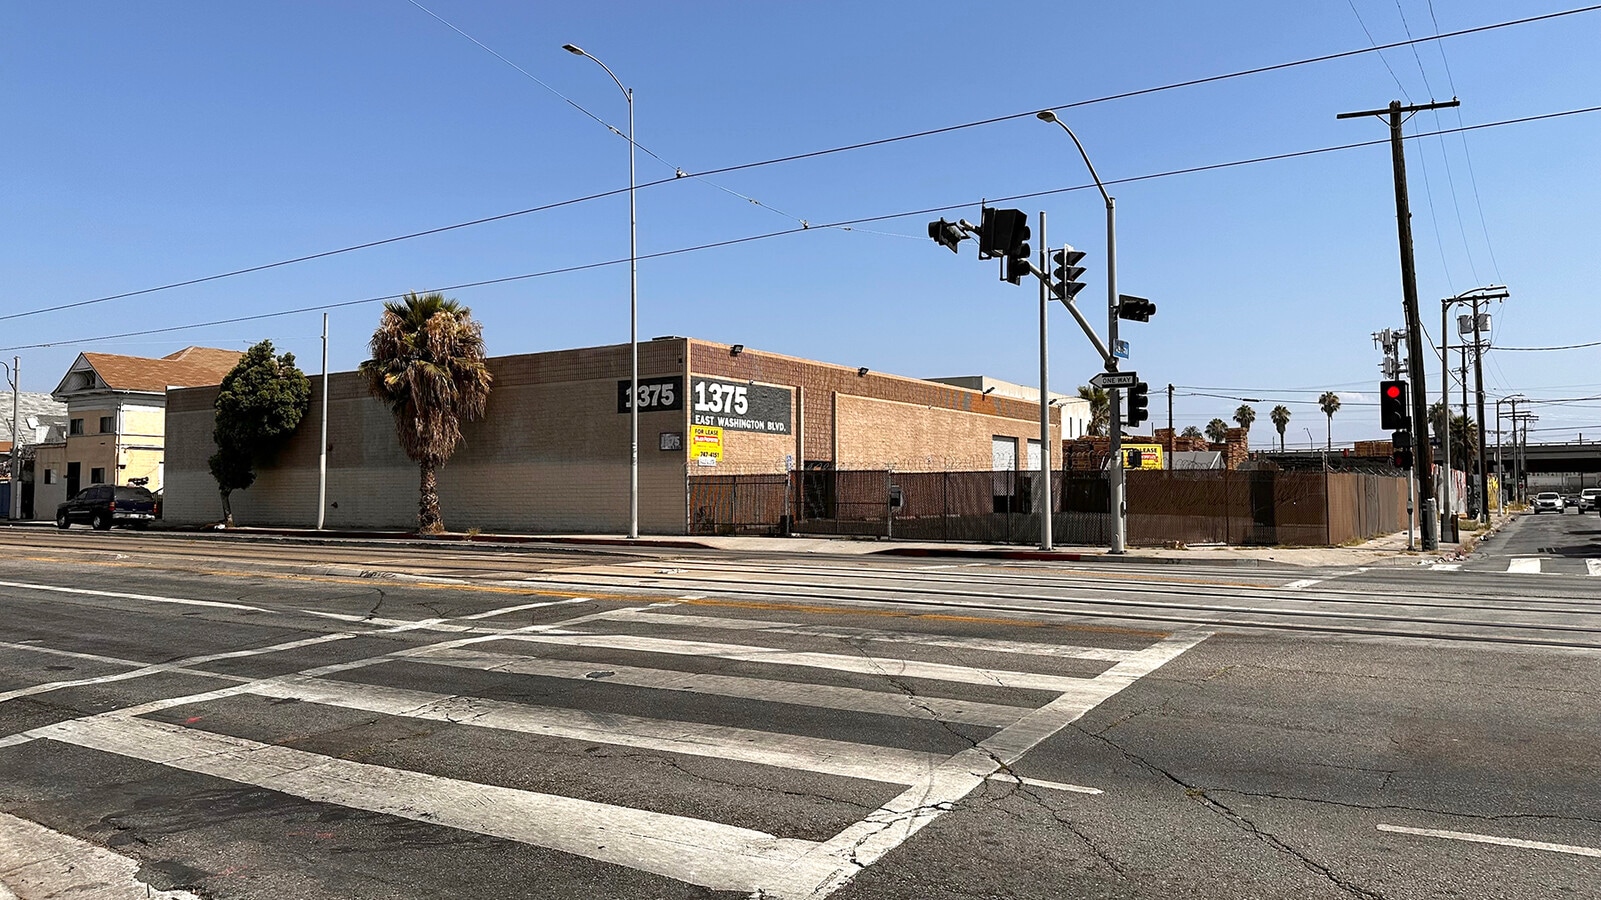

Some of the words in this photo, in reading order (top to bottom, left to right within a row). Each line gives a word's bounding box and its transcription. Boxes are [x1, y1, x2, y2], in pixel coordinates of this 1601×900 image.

[625, 383, 675, 407] 1375
[694, 381, 749, 415] 1375
[695, 414, 714, 426] EAST
[717, 416, 765, 430] WASHINGTON
[767, 421, 787, 432] BLVD.
